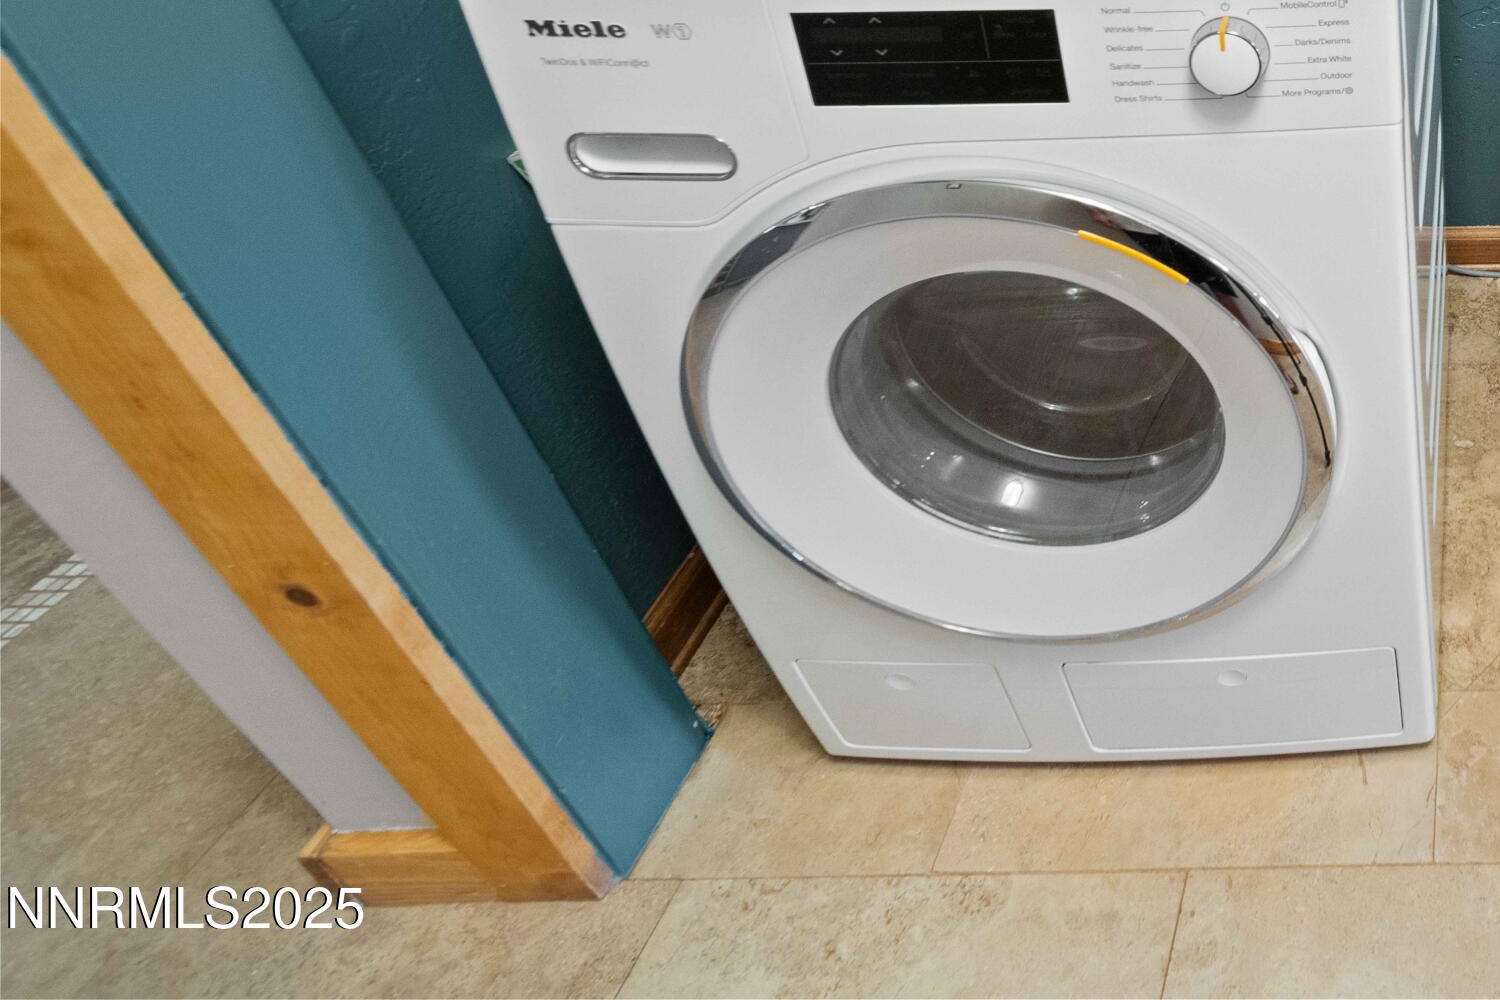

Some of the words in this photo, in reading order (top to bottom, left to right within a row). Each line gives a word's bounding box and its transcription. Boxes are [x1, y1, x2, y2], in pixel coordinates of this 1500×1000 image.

[1280, 0, 1337, 9] MobileControl
[1318, 18, 1351, 27] Express
[524, 19, 627, 39] Miele
[1294, 37, 1351, 46] Darks/Denims
[1306, 56, 1328, 64] Extra
[1329, 55, 1353, 63] White
[1320, 71, 1353, 80] Outdoor
[1281, 89, 1302, 97] More
